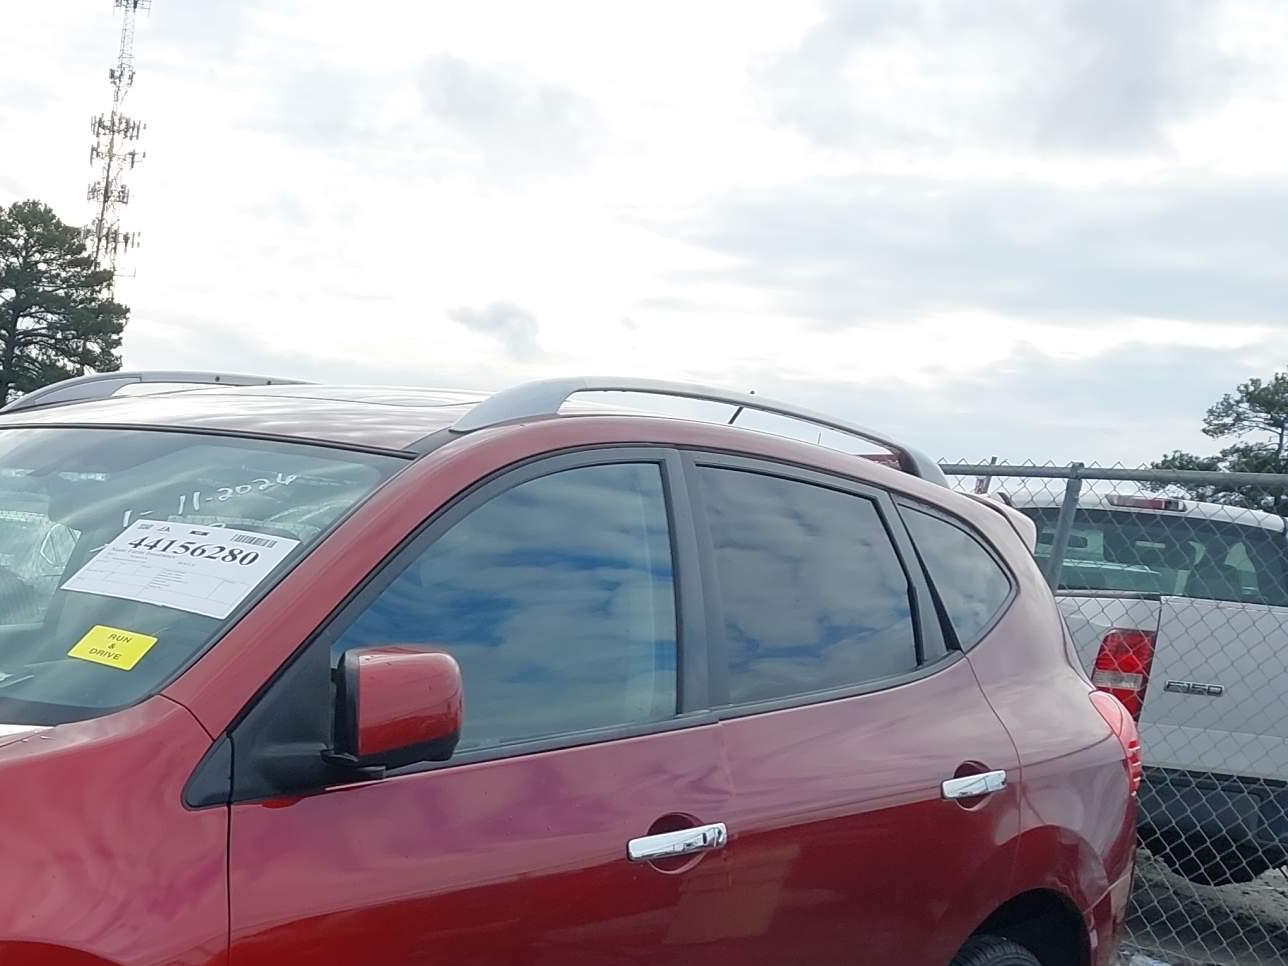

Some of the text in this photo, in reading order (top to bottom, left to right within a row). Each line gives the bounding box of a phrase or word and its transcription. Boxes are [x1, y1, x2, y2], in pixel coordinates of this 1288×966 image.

[127, 535, 261, 567] 44156280
[108, 633, 133, 644] RUN
[88, 647, 123, 661] DRIVE
